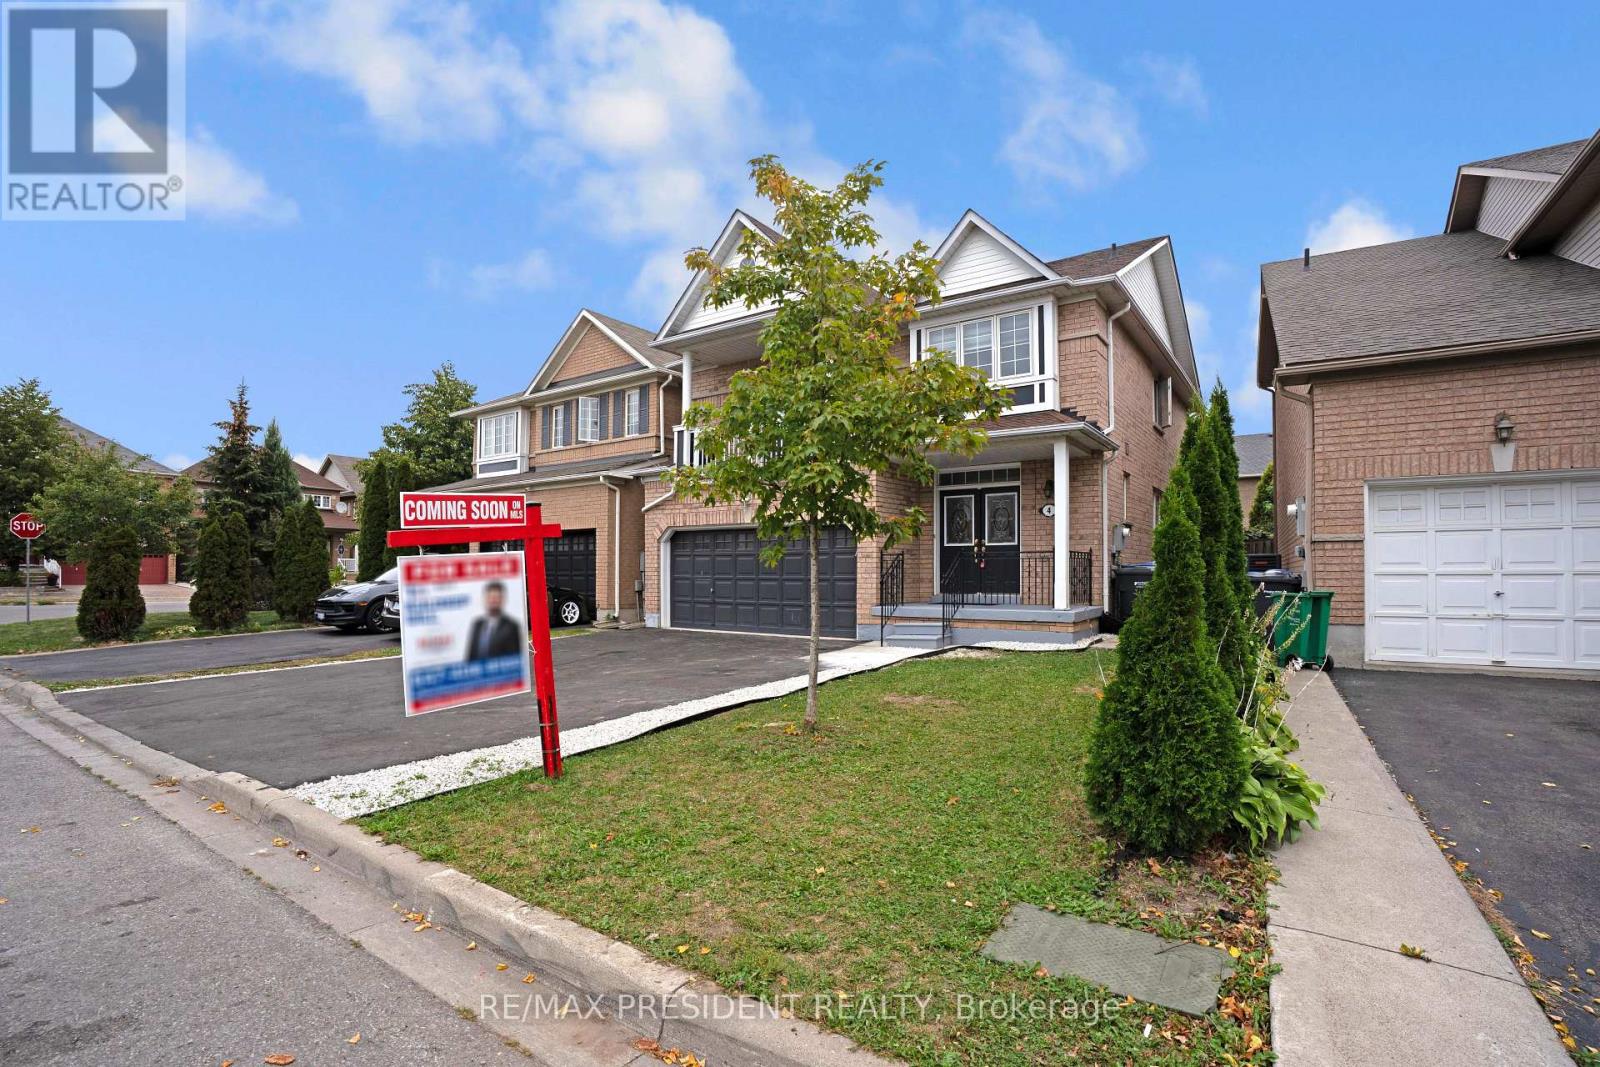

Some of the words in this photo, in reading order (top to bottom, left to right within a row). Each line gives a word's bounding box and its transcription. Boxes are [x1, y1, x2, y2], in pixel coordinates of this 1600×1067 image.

[512, 500, 521, 509] ON
[404, 500, 467, 520] COMING
[471, 500, 508, 519] SOON
[13, 521, 44, 530] STOP
